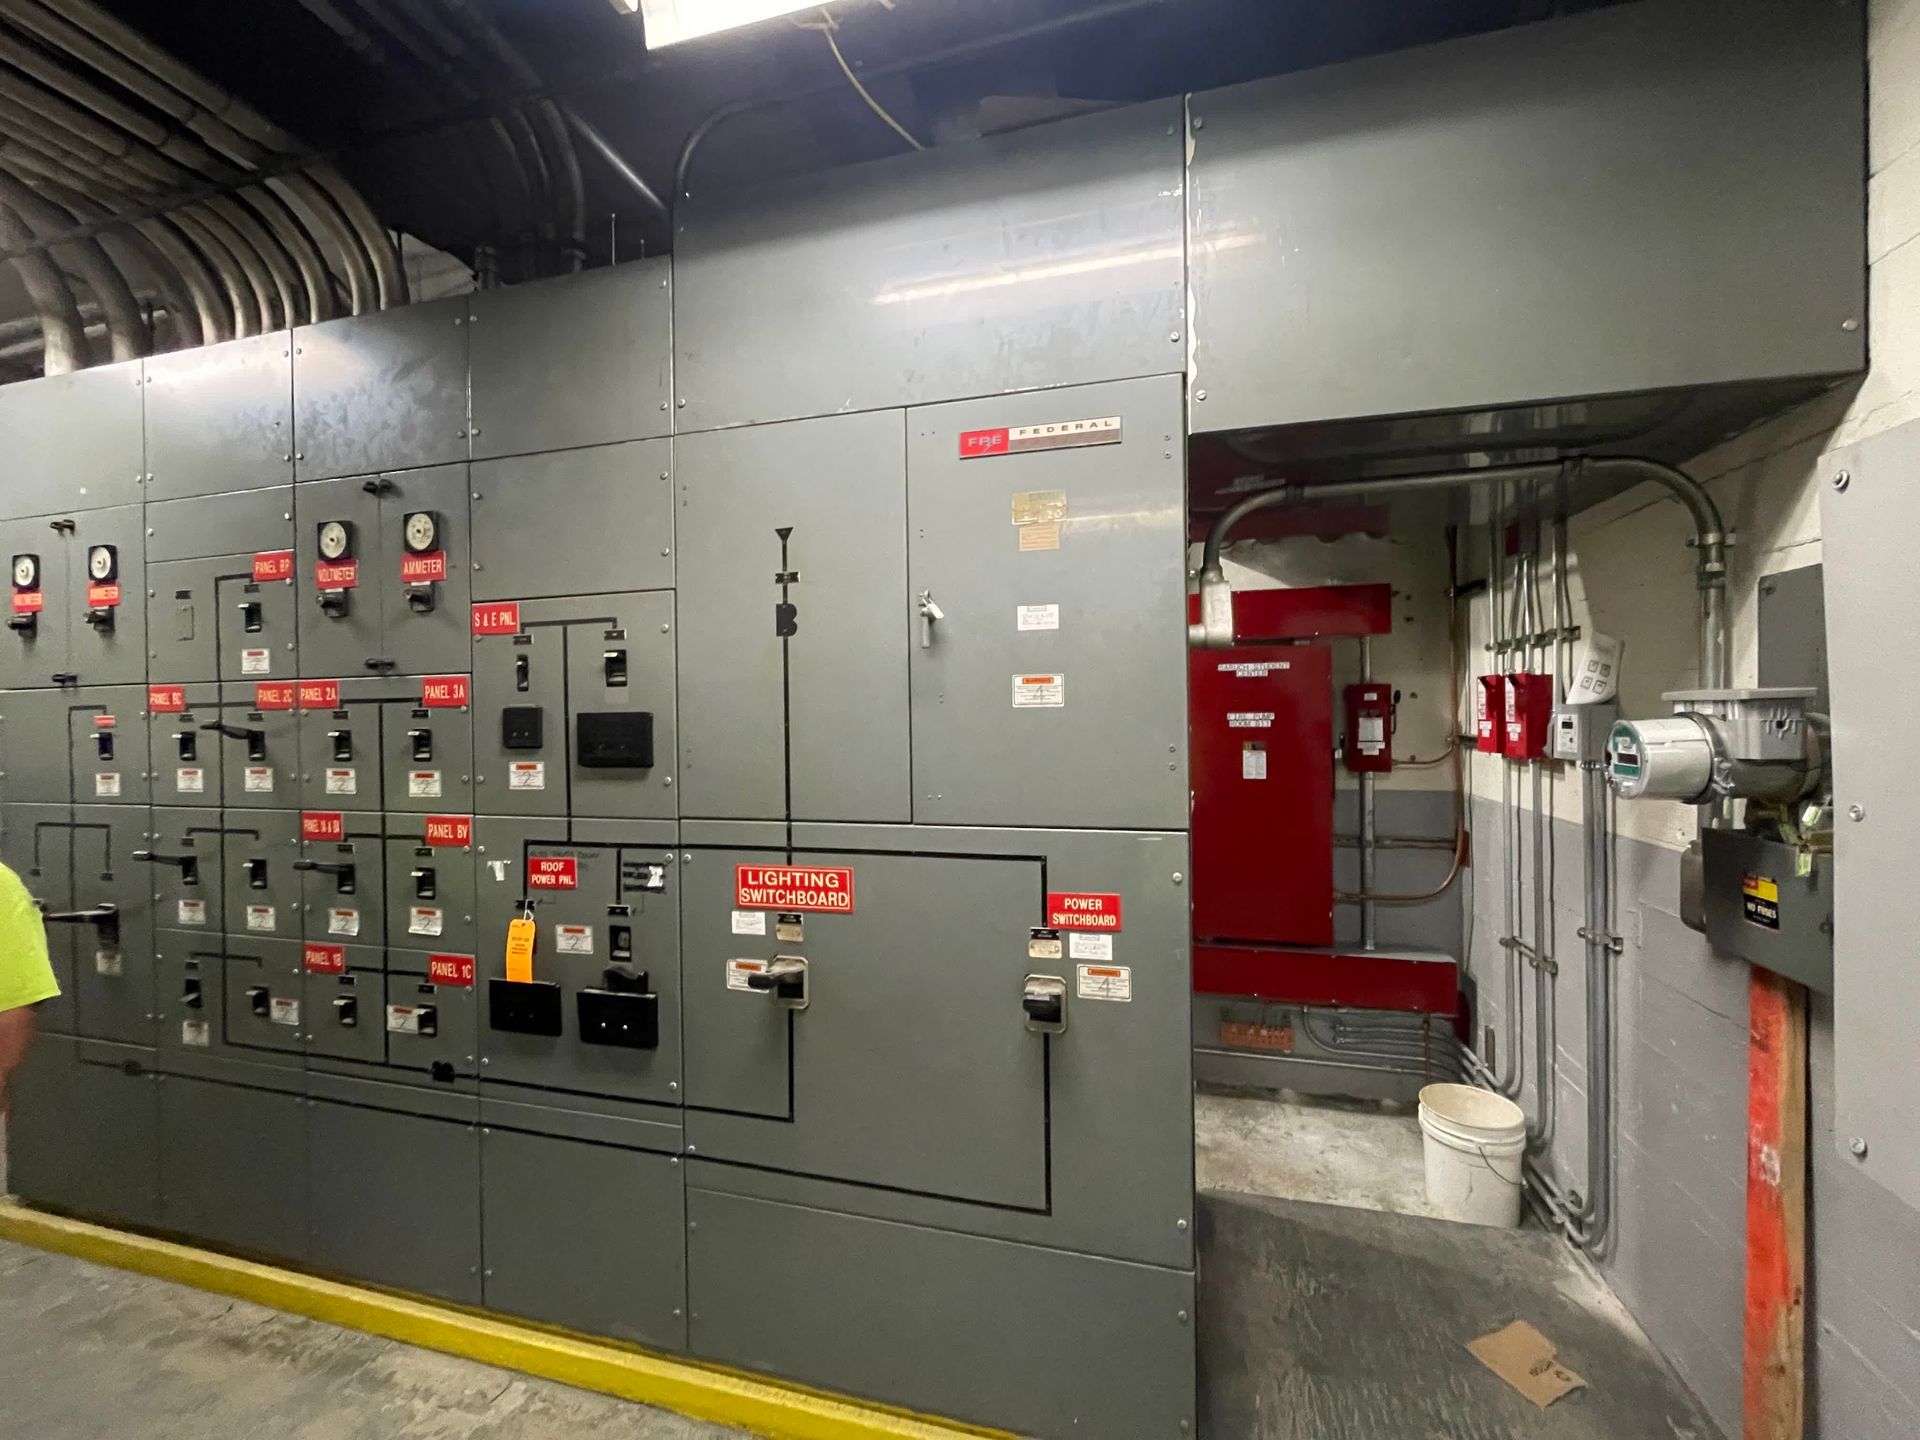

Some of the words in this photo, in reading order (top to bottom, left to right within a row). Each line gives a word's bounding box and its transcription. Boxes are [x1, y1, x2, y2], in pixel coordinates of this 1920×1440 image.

[1019, 420, 1113, 435] FEDERAL
[317, 566, 355, 582] VOLTMETER
[403, 559, 442, 574] AMMETER
[474, 612, 481, 627] S
[491, 612, 497, 627] E
[257, 689, 281, 703] PANEL
[283, 689, 293, 702] 2C
[300, 688, 323, 701] PANEL
[326, 687, 337, 700] 2A
[424, 685, 451, 699] PANEL
[453, 684, 464, 698] 3A
[428, 824, 453, 838] PANEL
[541, 861, 565, 872] ROOF
[531, 874, 556, 884] POWER
[748, 871, 839, 888] LIGHTING
[741, 888, 848, 906] SWITCHBOARD
[1064, 898, 1102, 910] POWER
[1052, 913, 1116, 926] SWITCHBOARD
[305, 951, 330, 966] PANEL
[431, 961, 459, 977] PANEL
[462, 964, 472, 979] 1C
